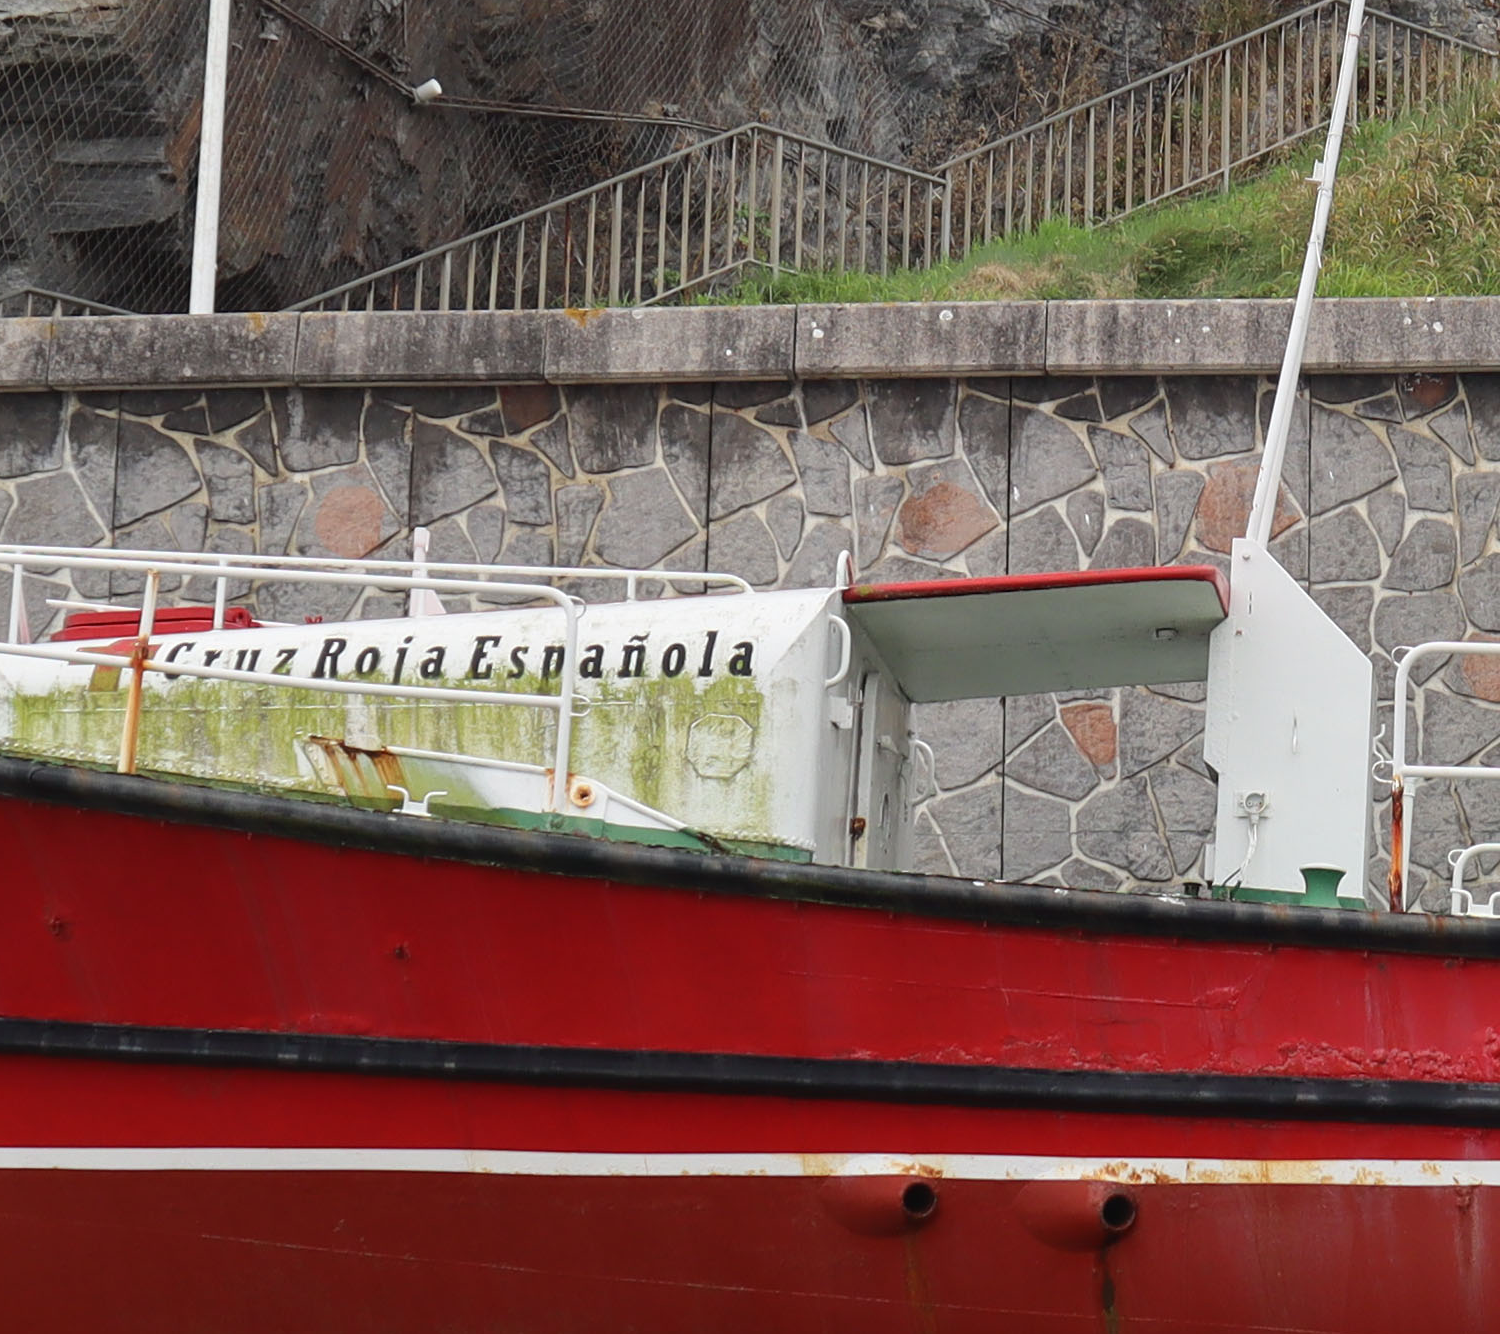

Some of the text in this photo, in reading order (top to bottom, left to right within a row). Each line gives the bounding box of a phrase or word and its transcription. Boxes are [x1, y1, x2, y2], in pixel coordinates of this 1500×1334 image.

[164, 630, 755, 692] Cruz Roja Española
